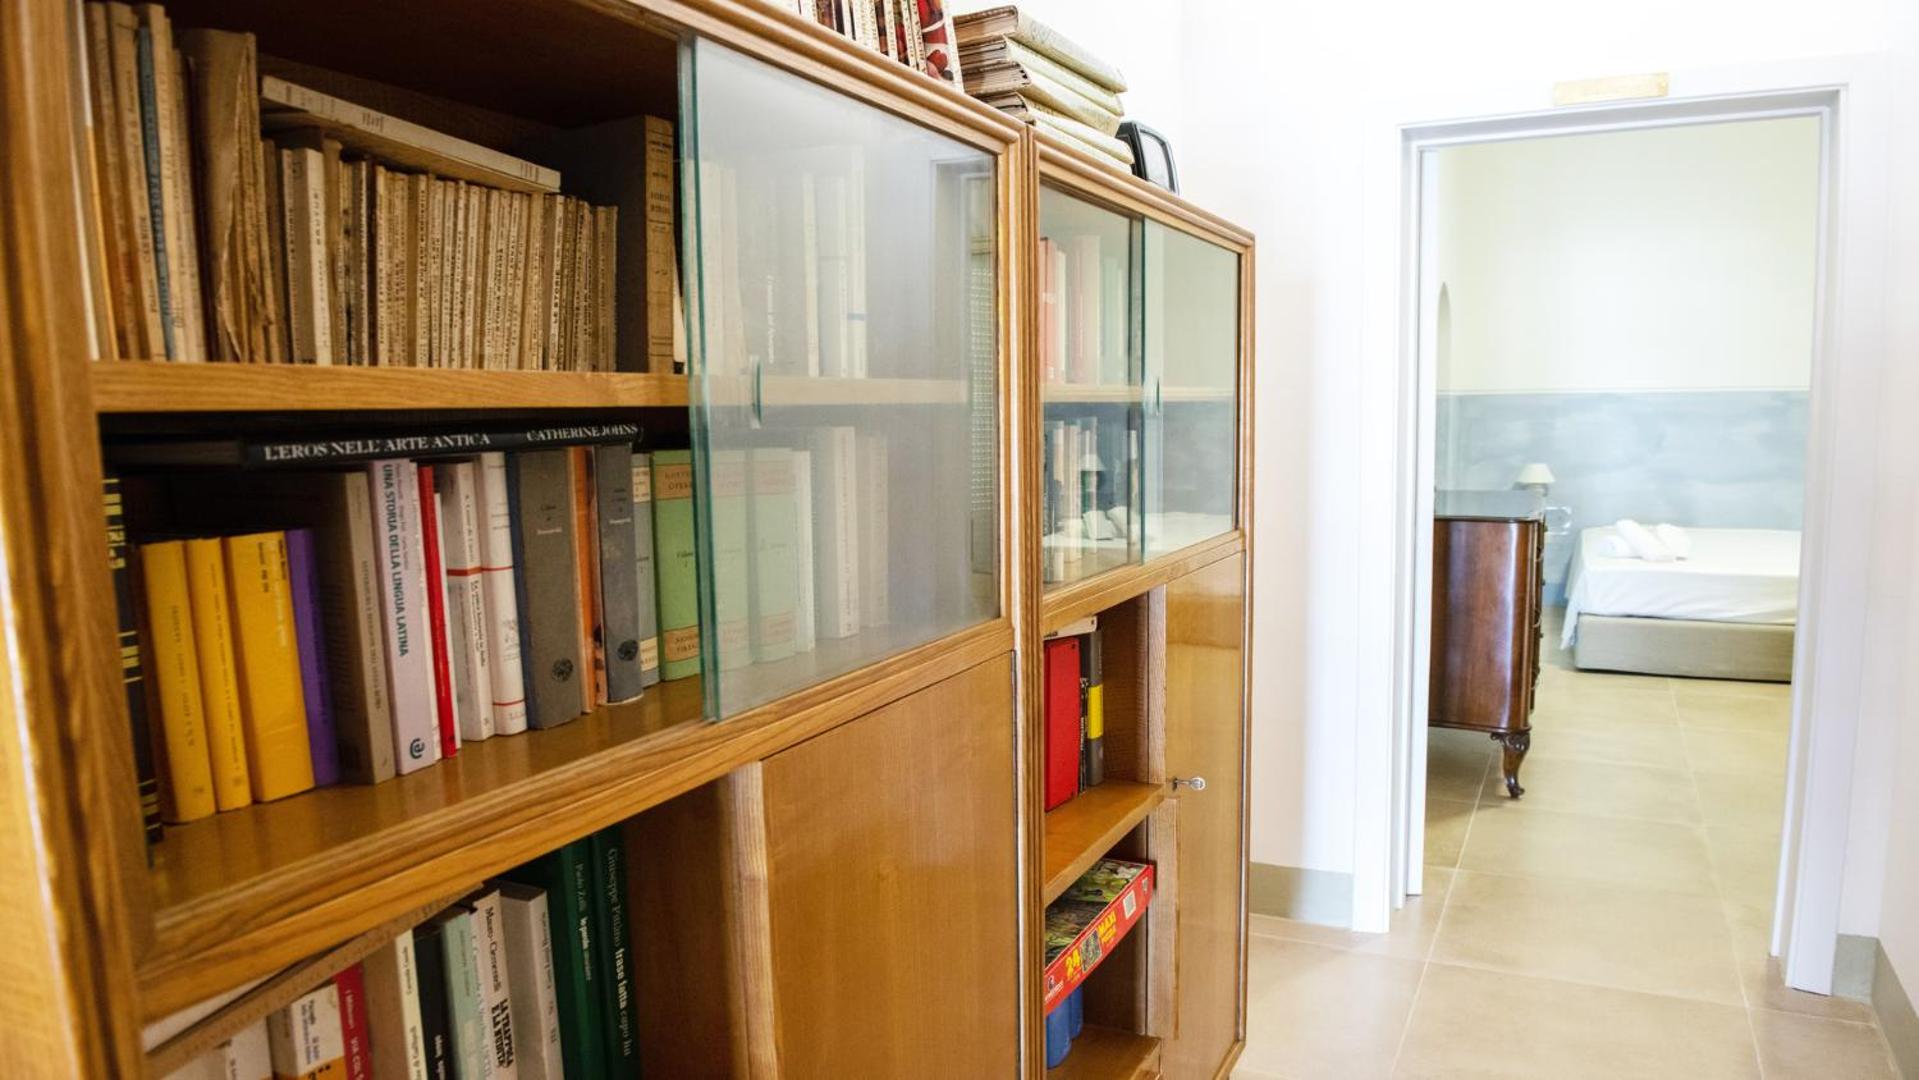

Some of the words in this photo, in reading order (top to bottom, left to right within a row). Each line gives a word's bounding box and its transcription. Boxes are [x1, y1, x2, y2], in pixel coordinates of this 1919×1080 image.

[384, 435, 429, 452] ARTE
[431, 433, 491, 449] ANTICA
[526, 426, 600, 442] CATHERINE
[601, 423, 639, 438] JOHNS
[382, 464, 393, 490] UNA
[384, 490, 398, 533] STORIA
[388, 533, 402, 570] DELLA
[392, 571, 405, 616] LINGUA
[396, 616, 410, 658] LATINA
[1065, 949, 1081, 979] 24
